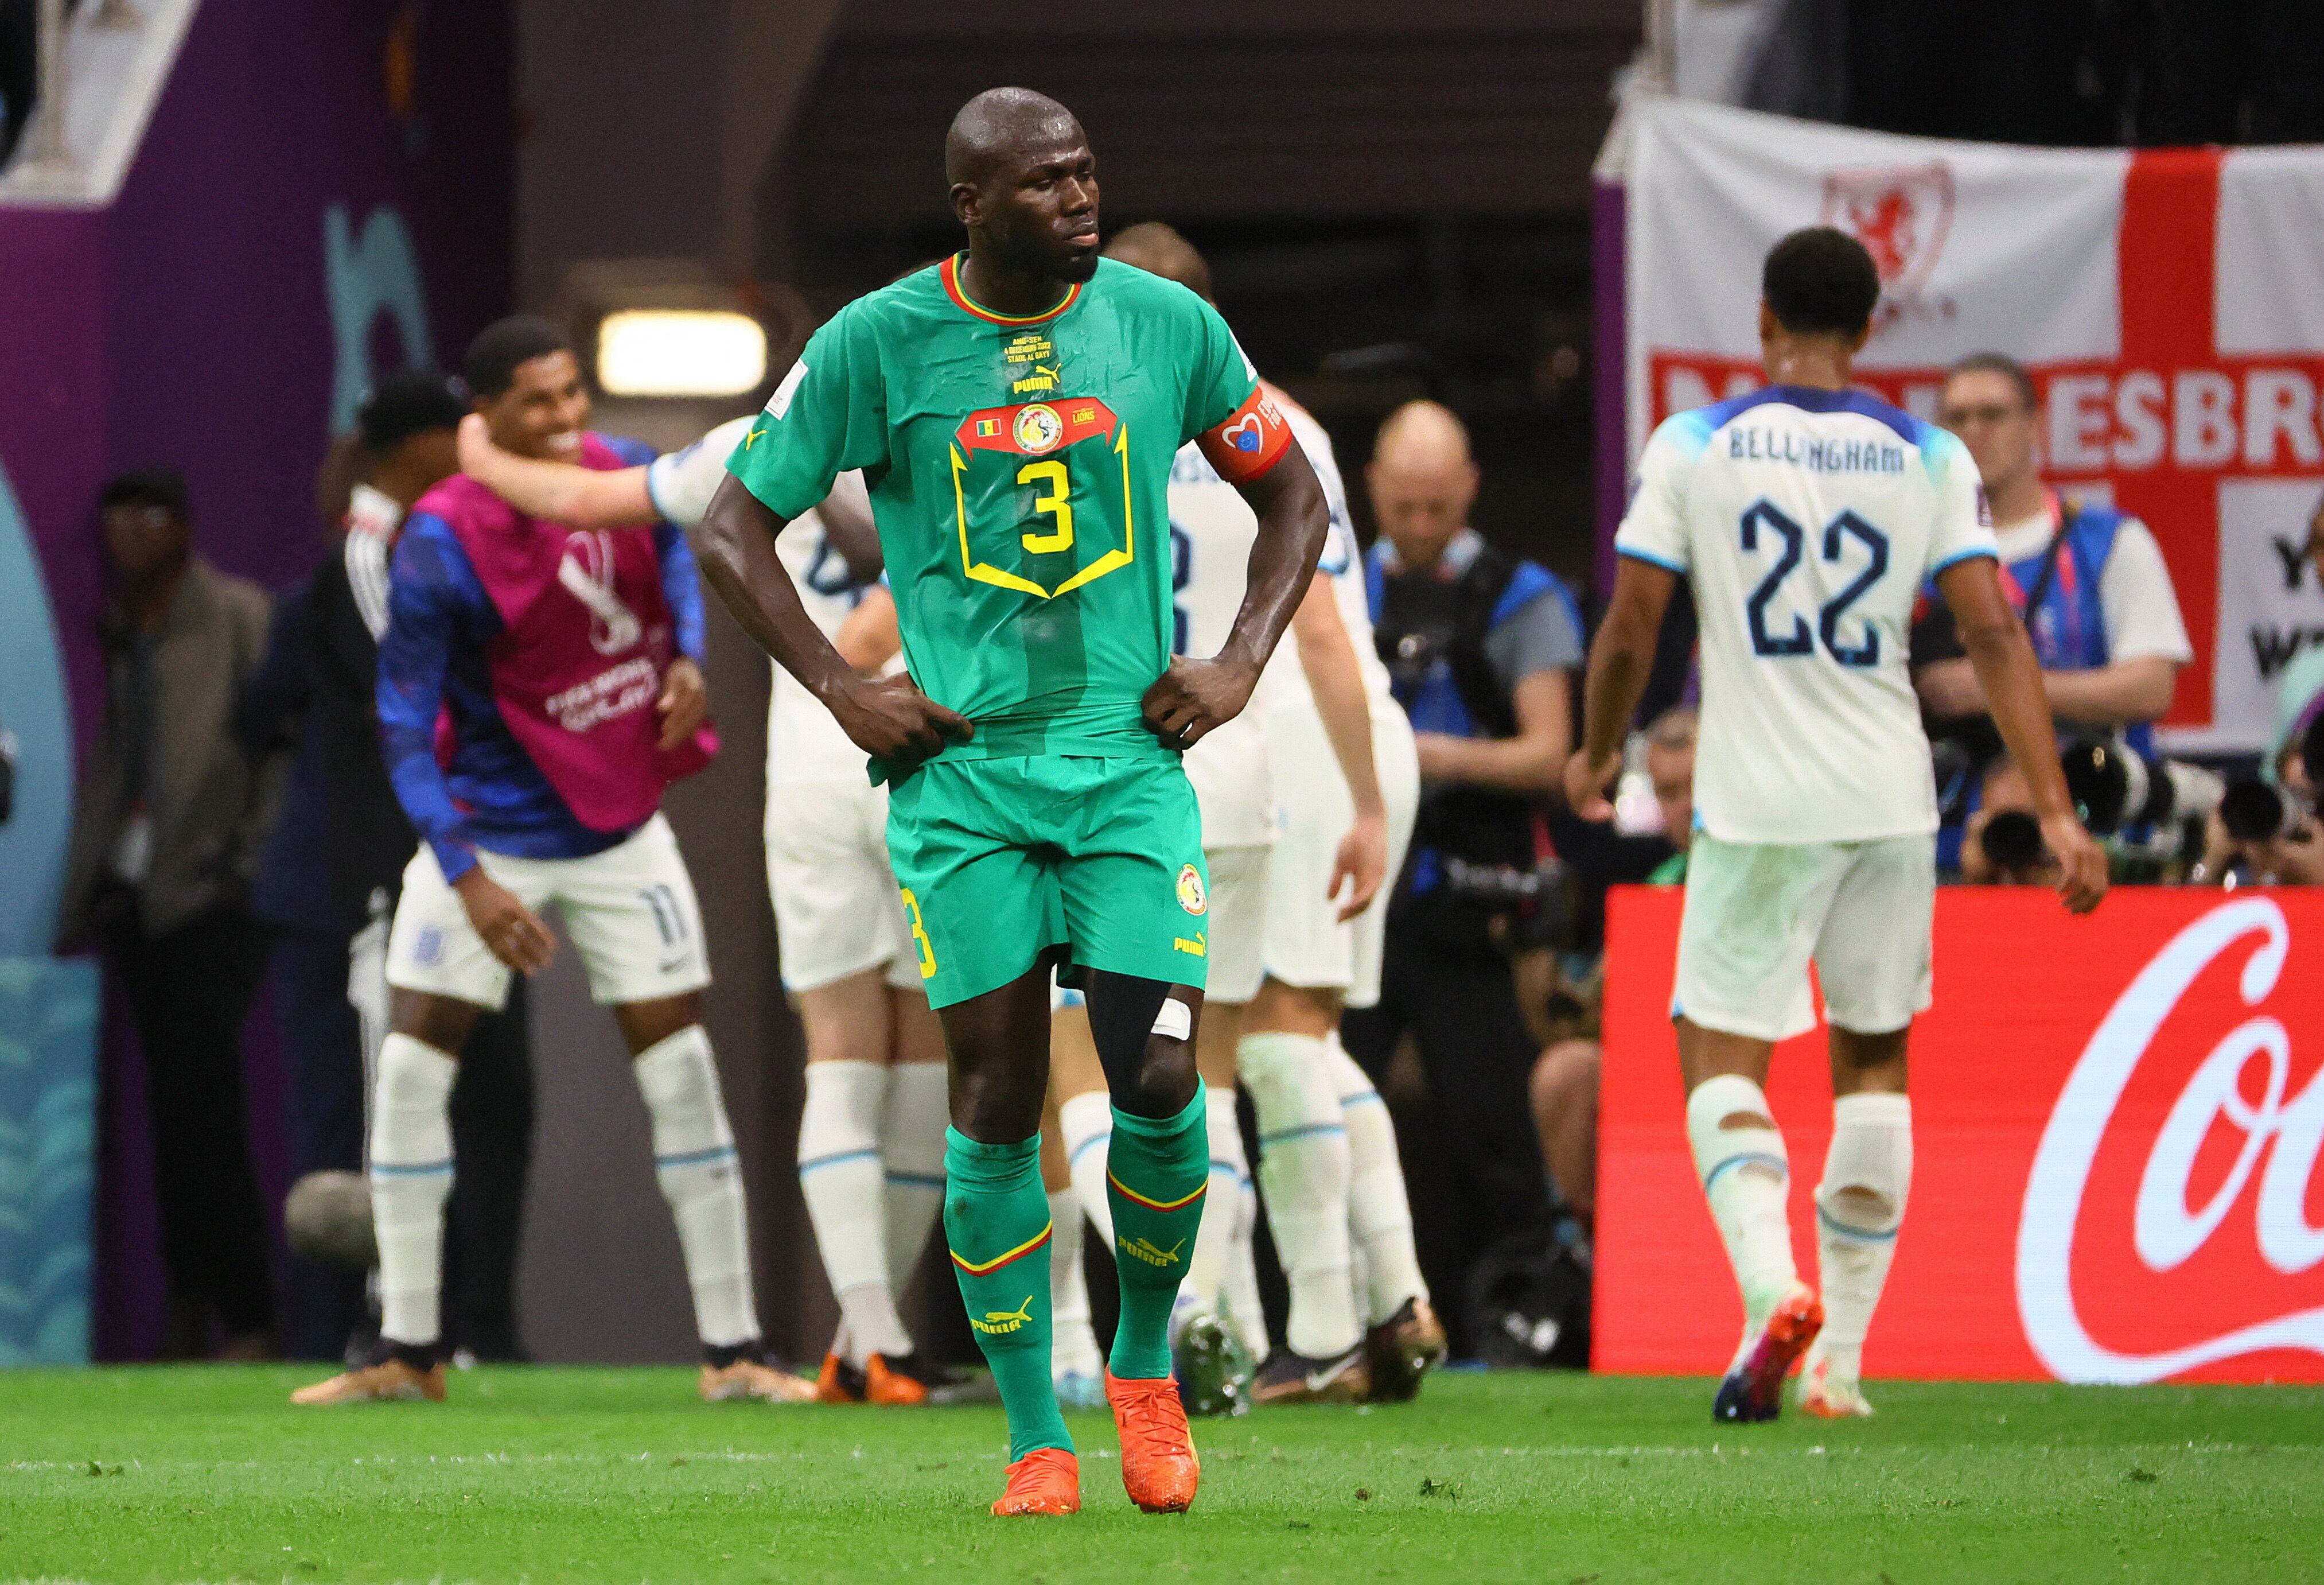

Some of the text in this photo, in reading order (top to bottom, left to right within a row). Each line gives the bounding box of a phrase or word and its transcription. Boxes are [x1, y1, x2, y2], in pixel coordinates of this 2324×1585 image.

[1013, 376, 1053, 394] PUMA
[1072, 410, 1095, 423] LIONS
[1017, 460, 1073, 554] 3
[1741, 498, 1889, 667] 22
[638, 884, 688, 946] 11
[901, 888, 937, 979] 3
[1174, 937, 1205, 958] PUMA
[1118, 1235, 1167, 1267] PUMA
[971, 1319, 1022, 1334] PUMA
